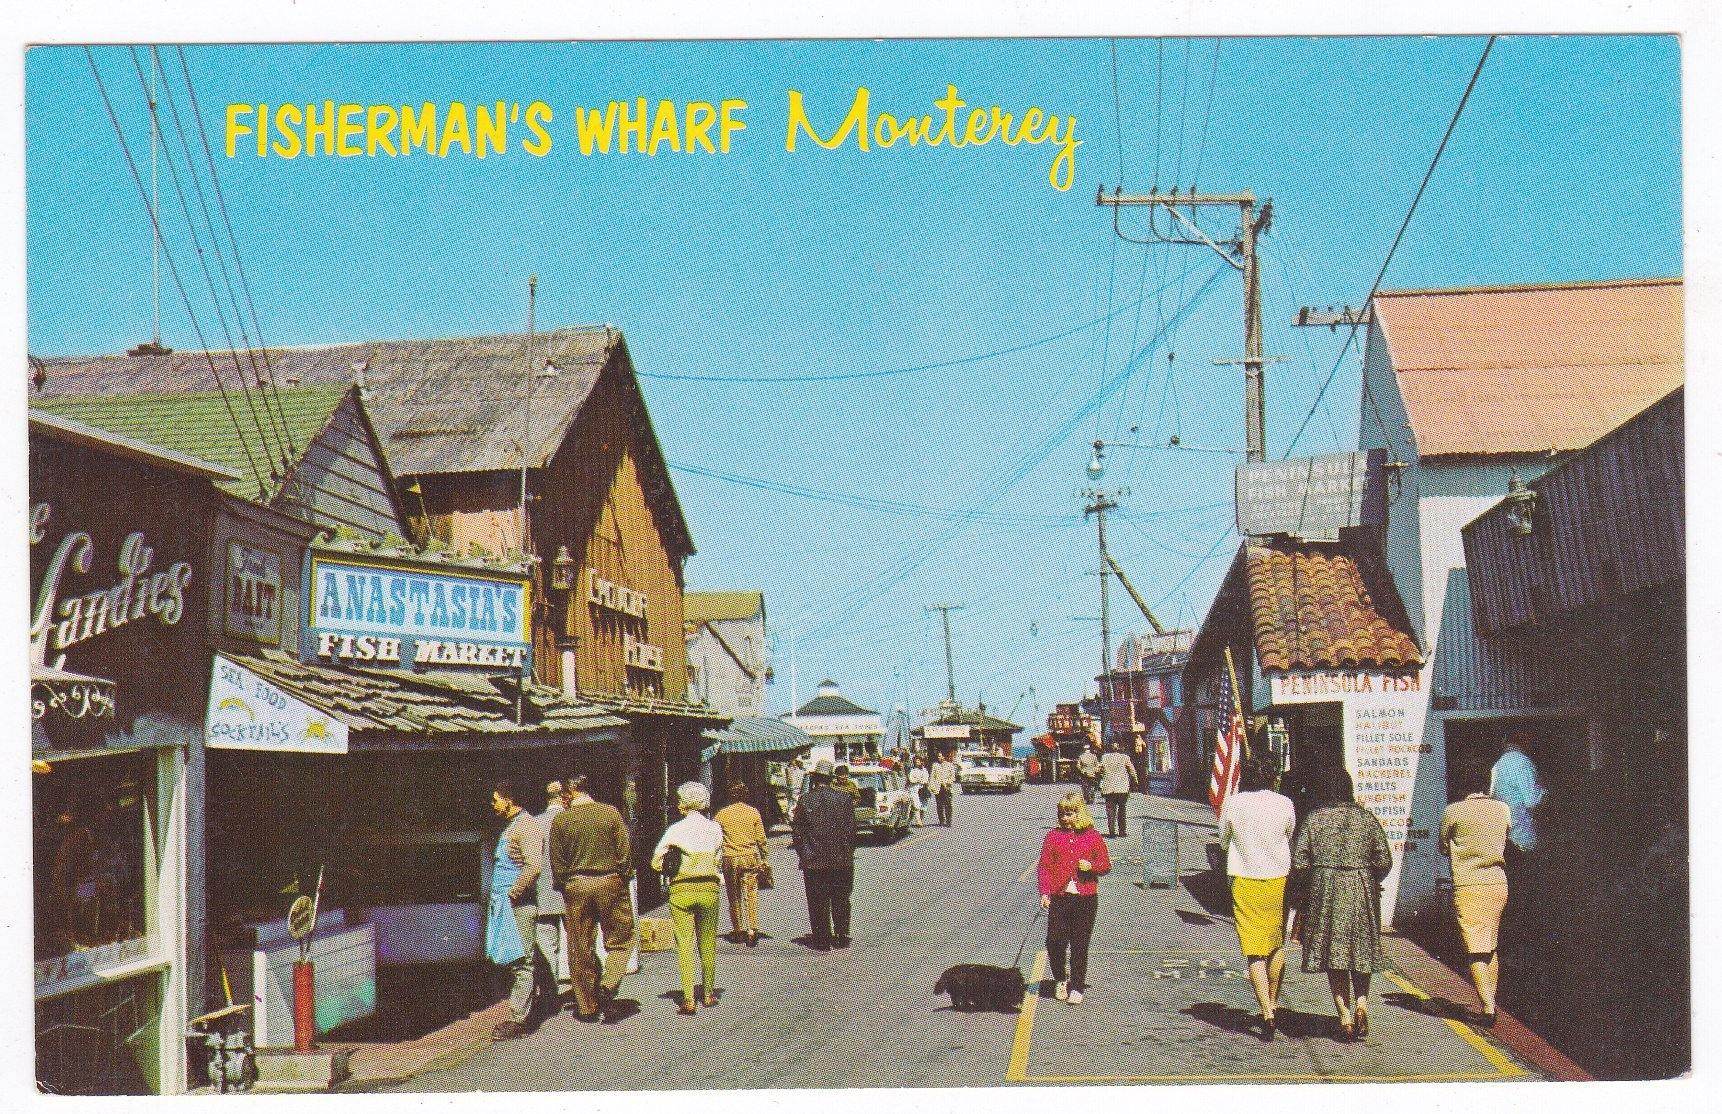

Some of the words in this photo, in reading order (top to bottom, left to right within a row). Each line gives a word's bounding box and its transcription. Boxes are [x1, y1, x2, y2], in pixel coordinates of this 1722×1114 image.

[1247, 458, 1367, 483] PENINSULA
[1247, 483, 1287, 501] FISH
[319, 571, 517, 634] ANASTASIA'S
[317, 632, 401, 661] FISH
[413, 638, 527, 670] MARKET
[1280, 672, 1373, 696] PENINSULA
[1382, 672, 1421, 693] FISH
[255, 680, 287, 710] FOOD
[1355, 707, 1406, 718] SALMON
[1356, 733, 1385, 743] FILLET
[1389, 732, 1414, 742] SOLE
[1357, 757, 1410, 768] SANDABS
[1357, 781, 1398, 792] SMELTS
